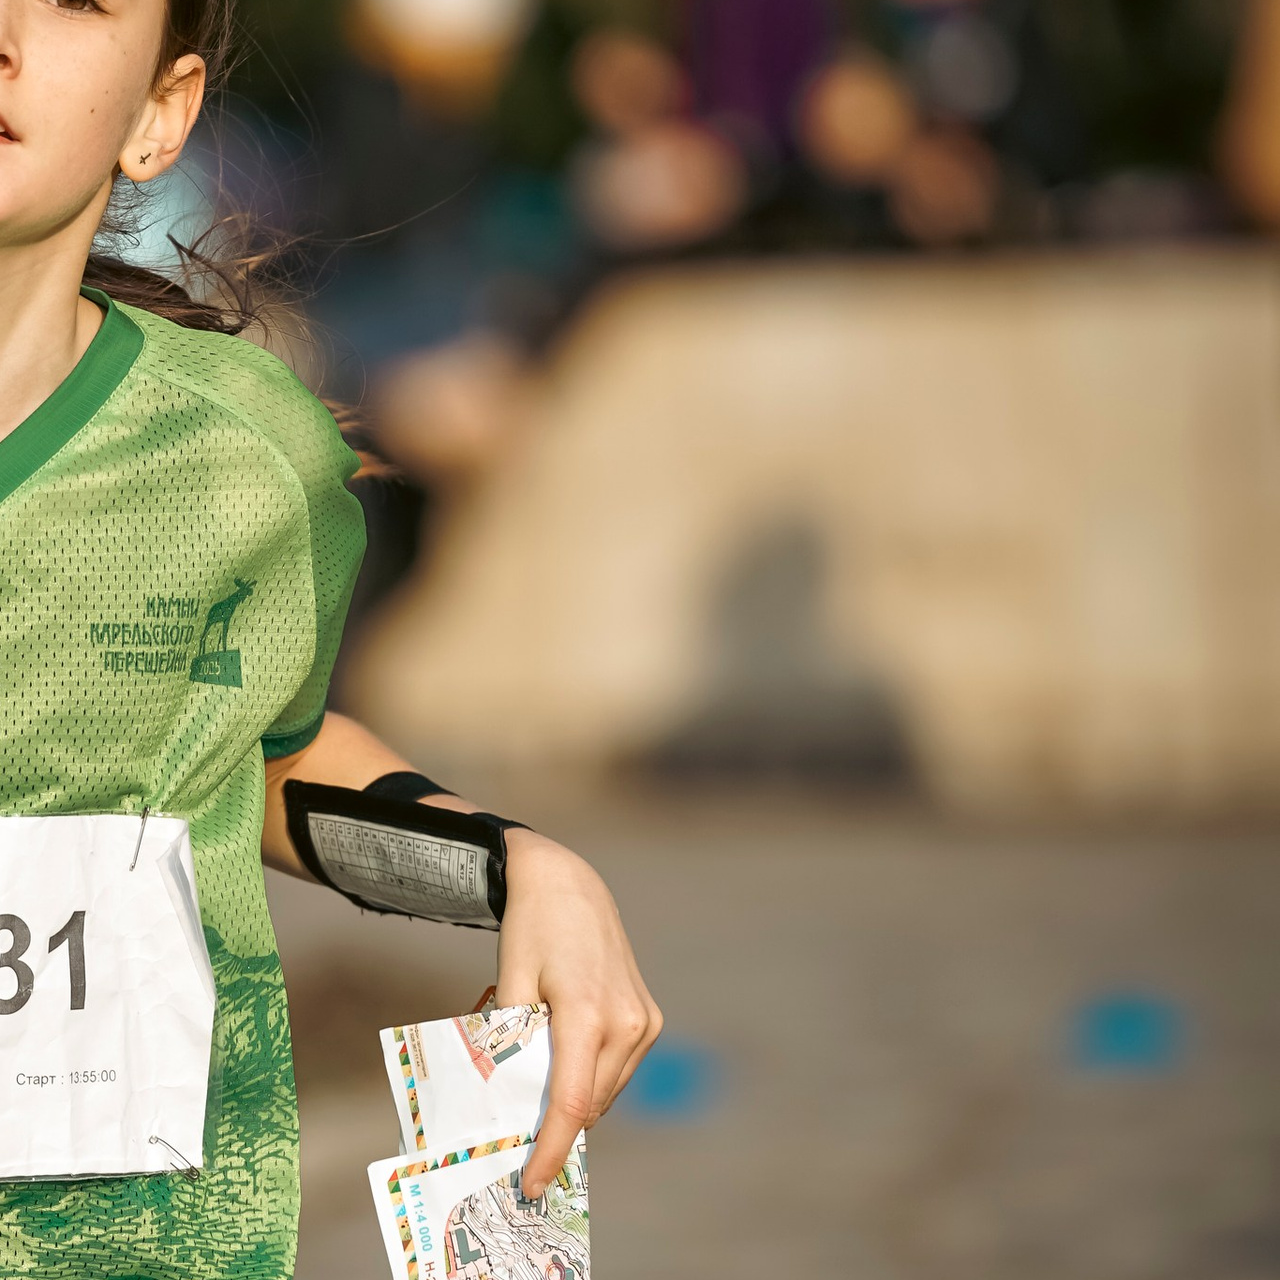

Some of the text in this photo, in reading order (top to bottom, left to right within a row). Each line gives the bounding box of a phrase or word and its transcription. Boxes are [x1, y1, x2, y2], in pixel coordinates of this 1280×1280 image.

[146, 596, 200, 618] КАМНИ
[89, 622, 194, 646] КАРЕЛЬСКОГО
[15, 1072, 57, 1088] Старт
[68, 1069, 117, 1085] 13:55:00
[413, 1201, 428, 1223] 1:4
[418, 1226, 433, 1252] 000
